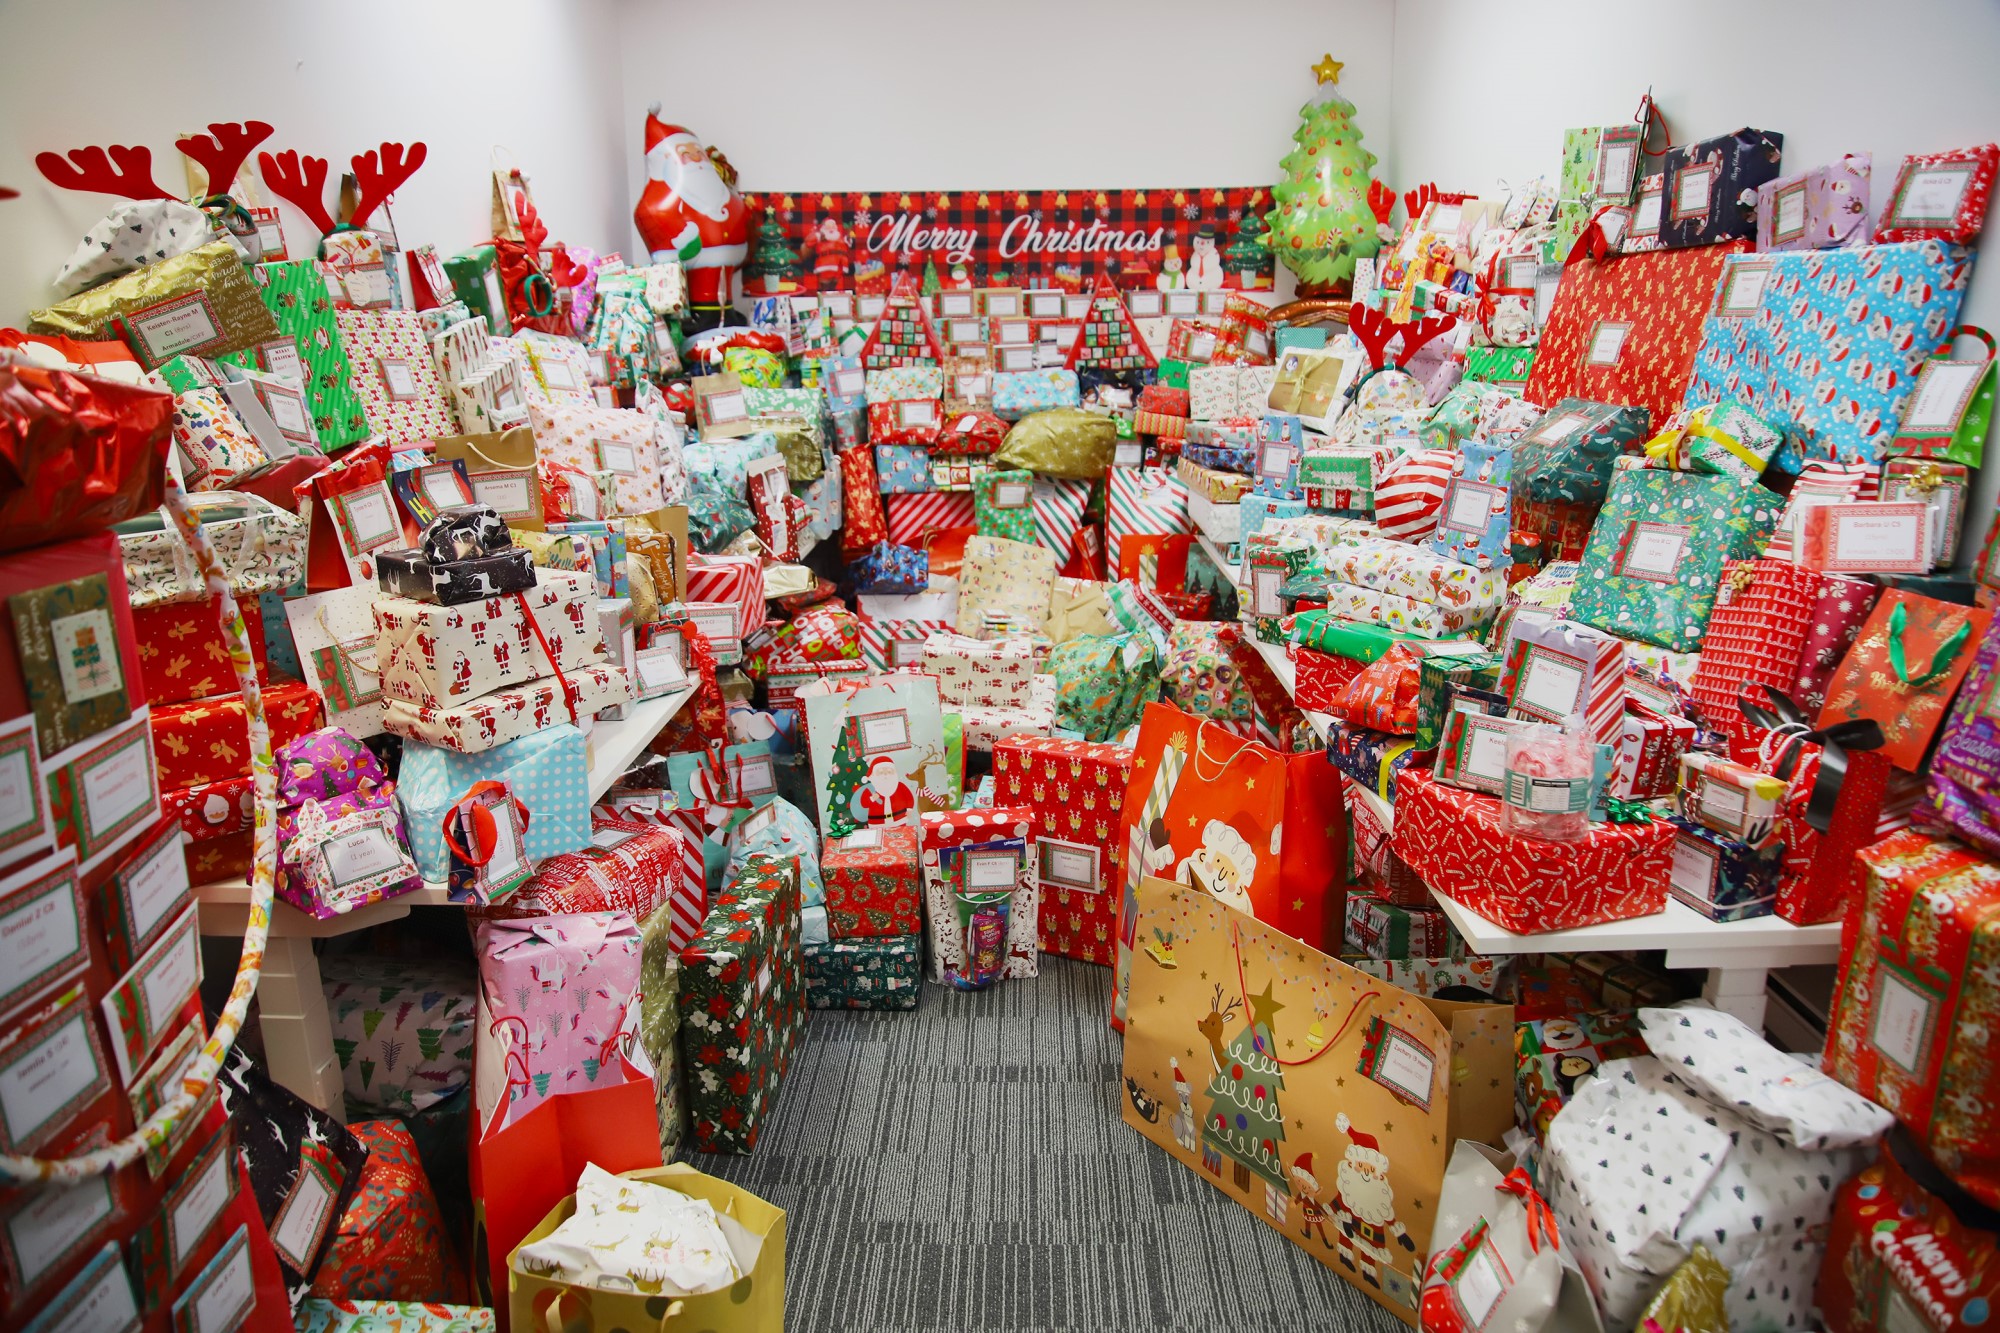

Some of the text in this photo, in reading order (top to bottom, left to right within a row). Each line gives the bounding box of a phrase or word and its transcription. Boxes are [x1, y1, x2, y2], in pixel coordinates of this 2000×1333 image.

[867, 213, 1165, 264] Merry Christmas
[347, 839, 365, 848] Luca
[359, 848, 376, 858] year)
[1901, 1233, 1967, 1297] Merry
